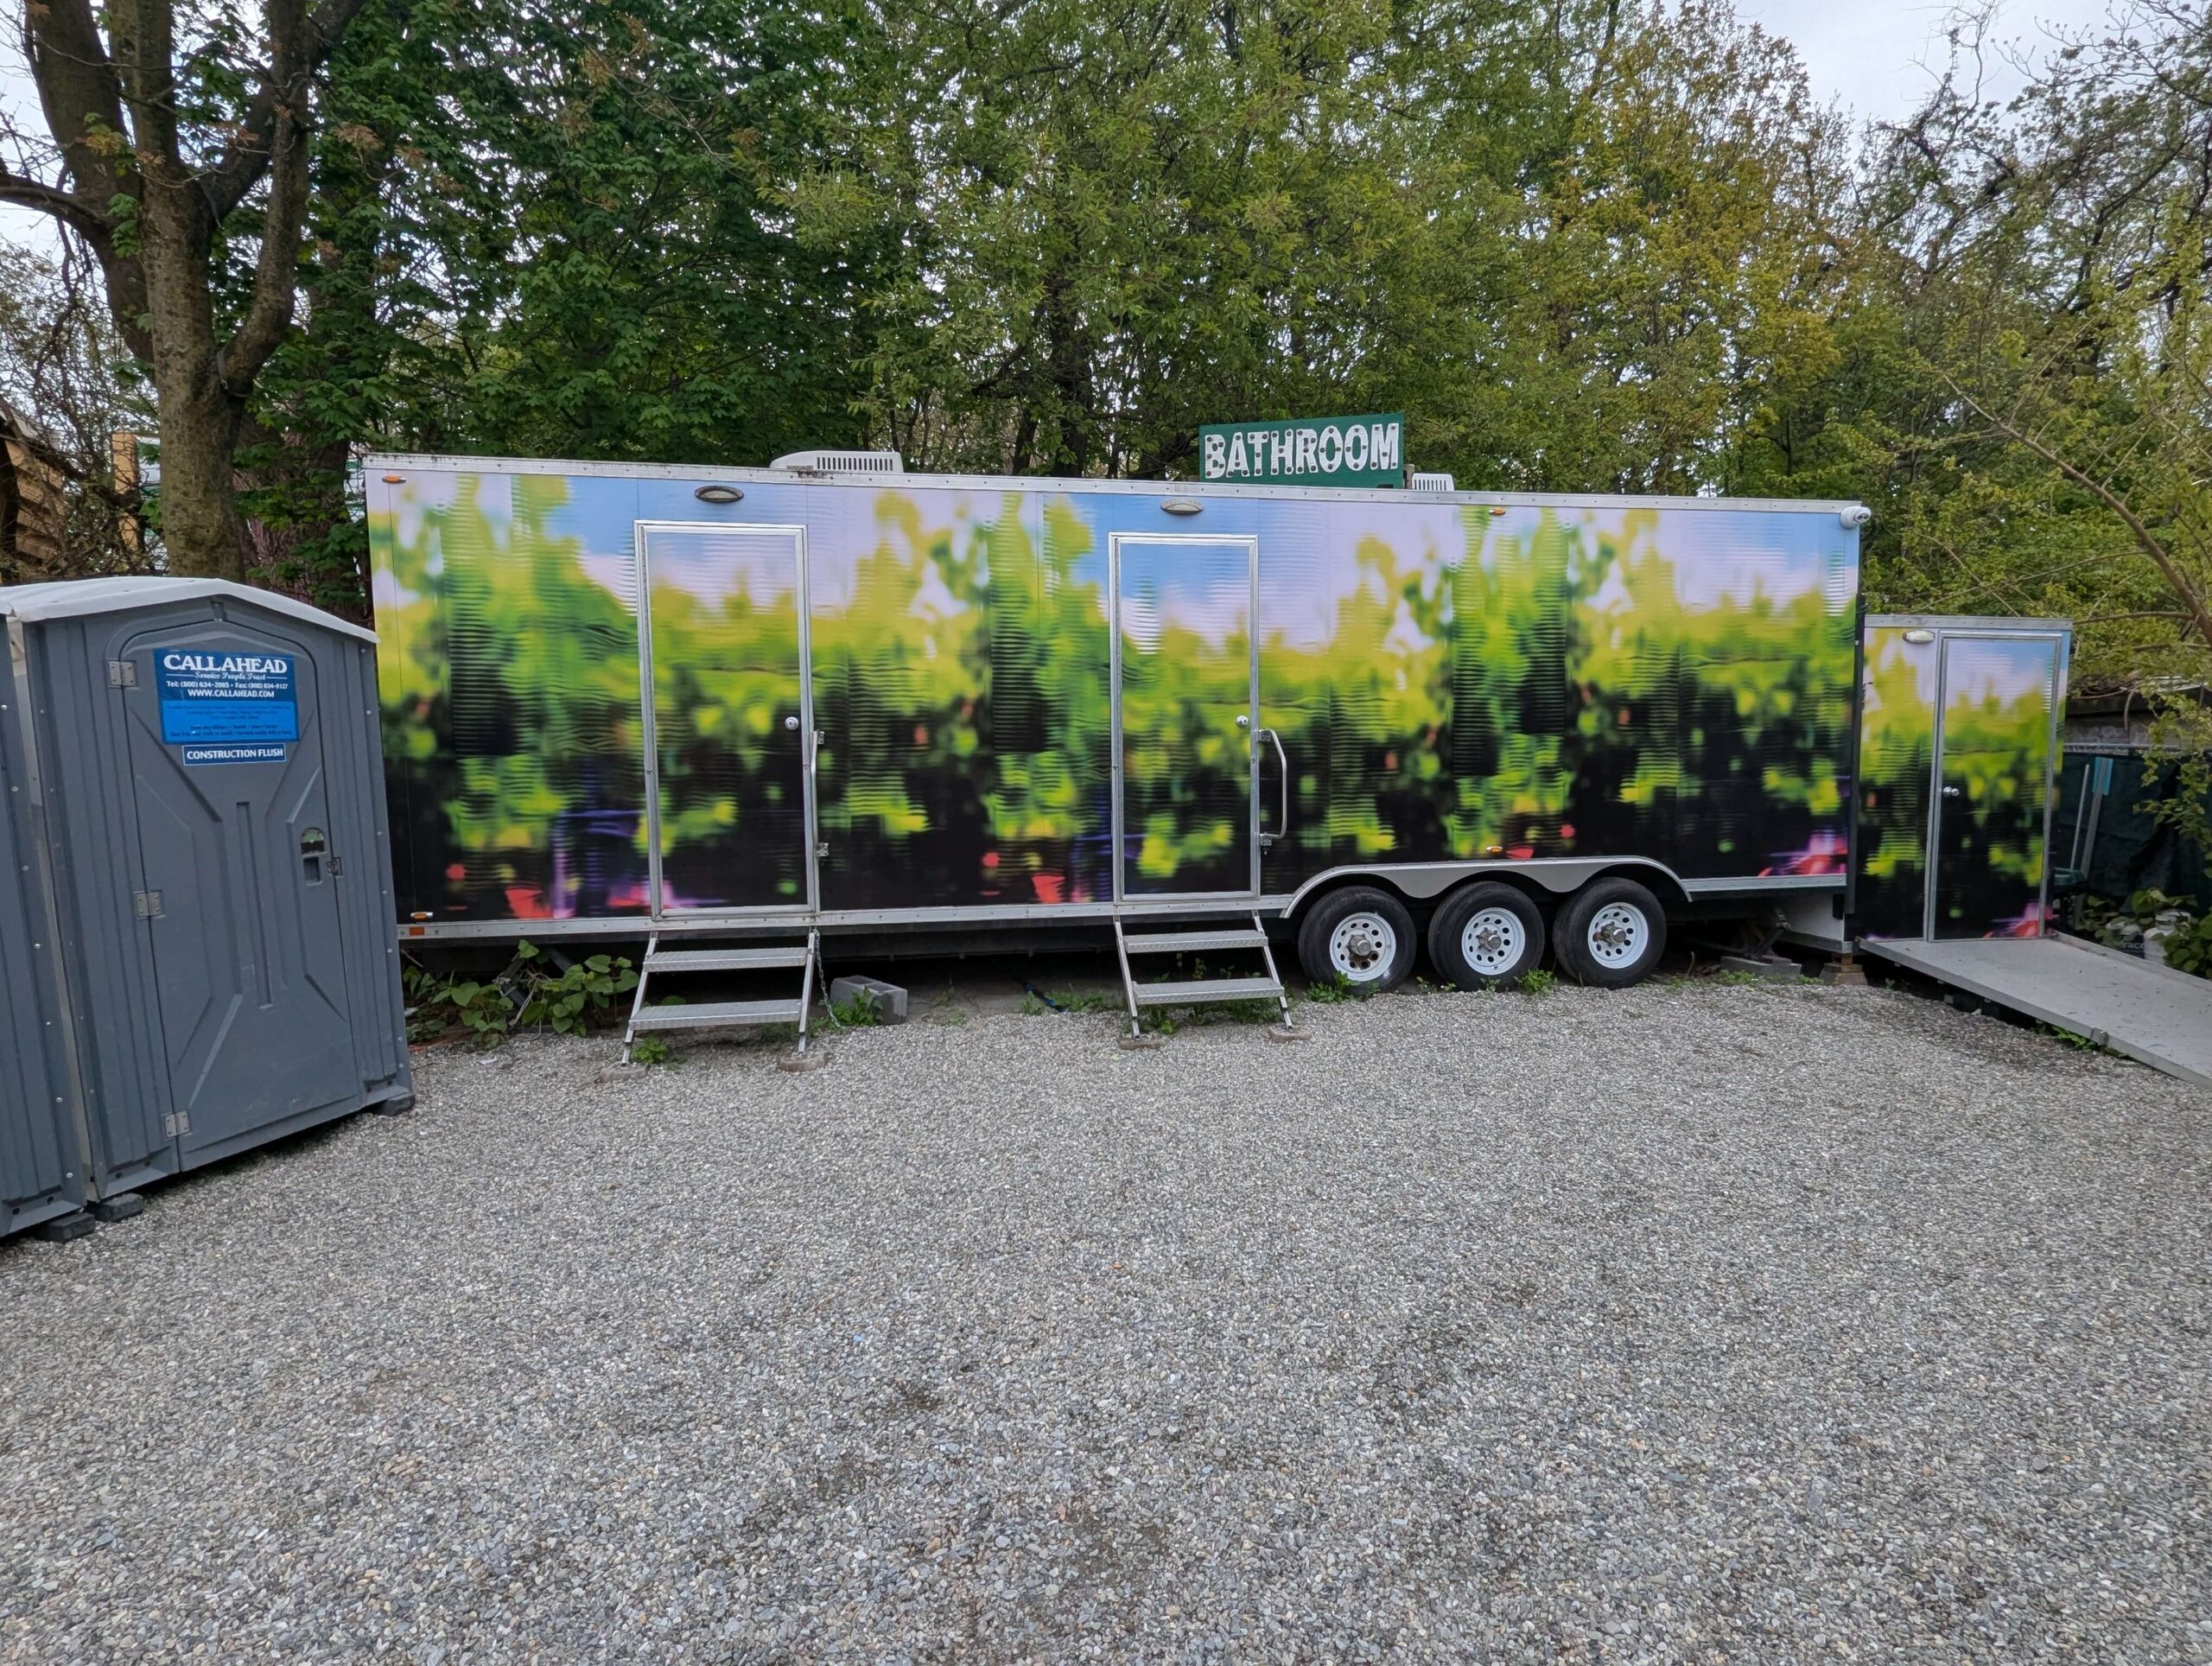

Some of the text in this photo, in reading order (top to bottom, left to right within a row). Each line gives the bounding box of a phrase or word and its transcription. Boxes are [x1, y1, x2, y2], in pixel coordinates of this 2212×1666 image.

[1205, 423, 1399, 479] BATHROOM
[163, 654, 288, 674] CALLAHEAD
[222, 671, 245, 681] People
[188, 689, 275, 697] WWW.CALLAHEAD.COM
[187, 748, 283, 760] CONSTRUCTION FLUSH
